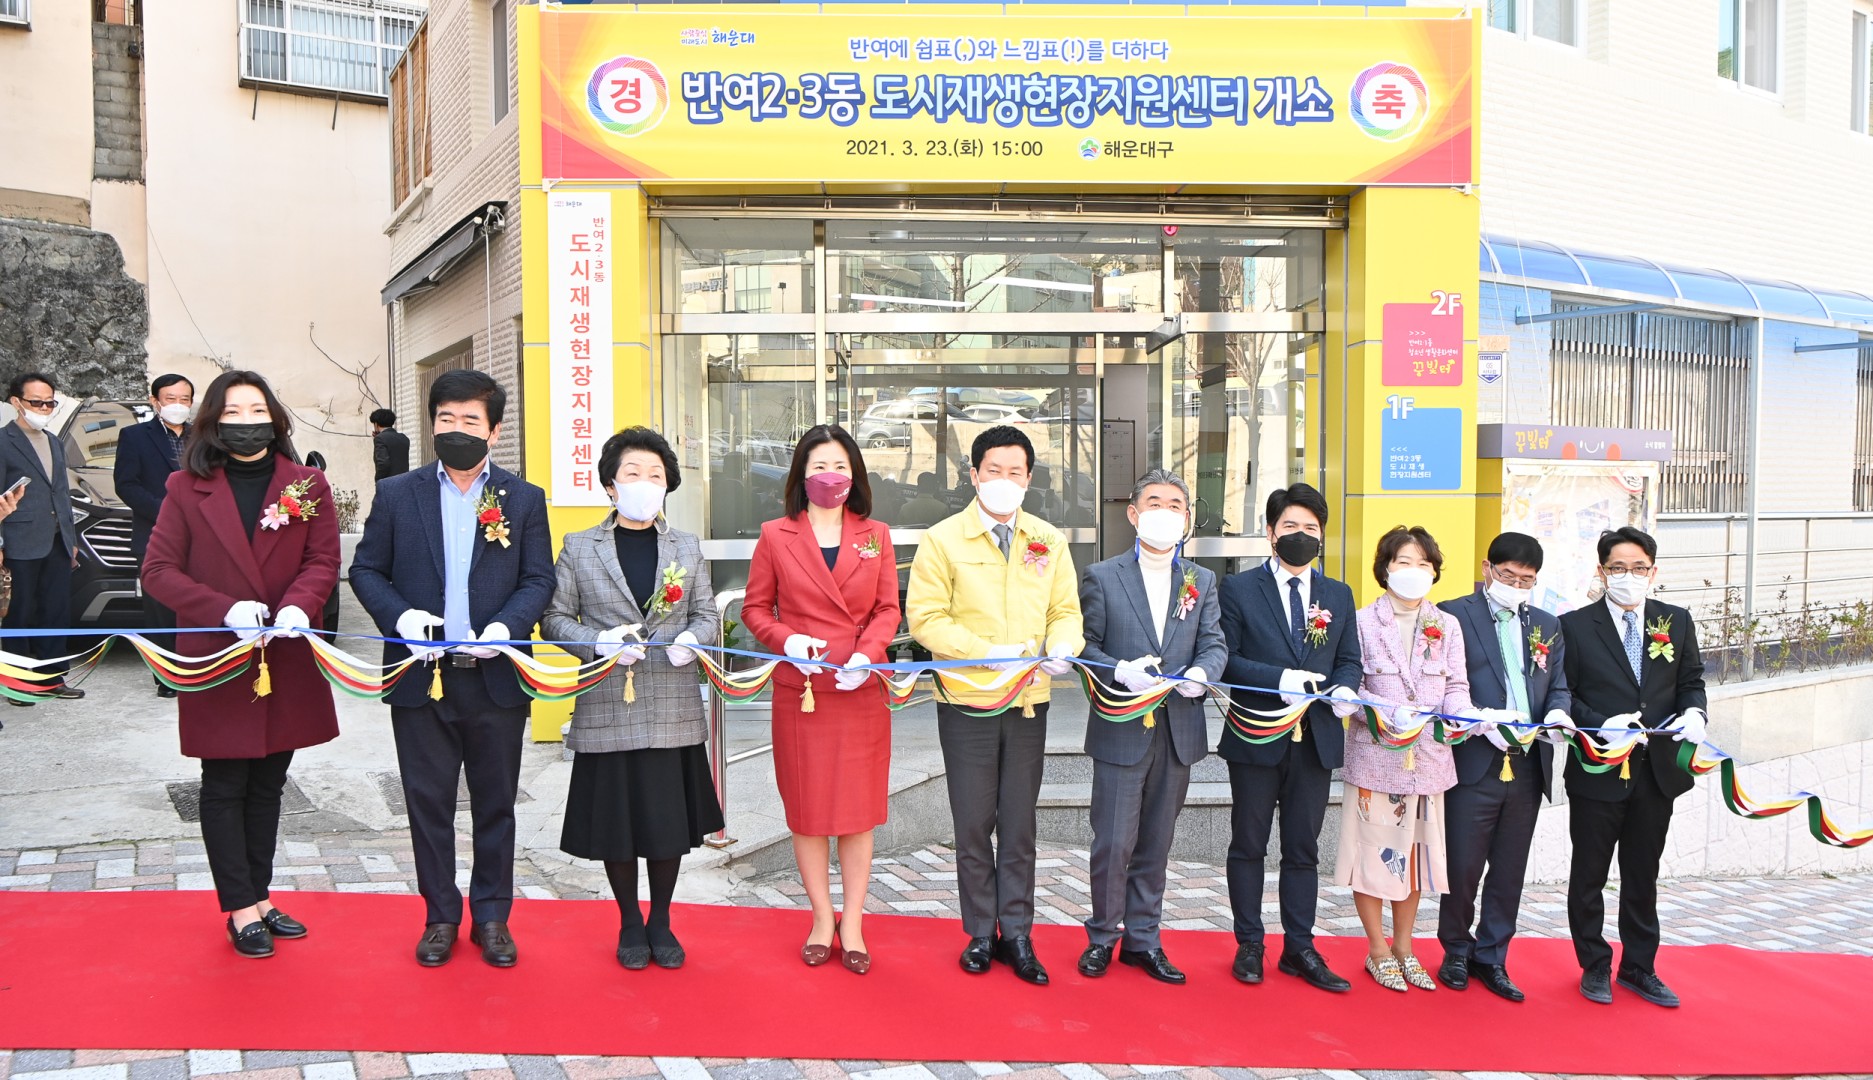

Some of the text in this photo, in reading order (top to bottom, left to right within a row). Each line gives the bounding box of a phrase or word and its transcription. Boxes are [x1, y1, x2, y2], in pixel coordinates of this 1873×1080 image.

[712, 30, 755, 47] 해운대
[850, 38, 1169, 62] 반여에 쉼표(,)와 느낌표(!)를 더하다
[609, 77, 642, 114] 경
[681, 71, 1333, 128] 반여2·3동 도시재생현장지원센터 개소
[1371, 84, 1407, 119] 축
[846, 139, 1043, 158] 2021. 3. 23.(화) 15:00
[1104, 140, 1174, 159] 해운대구
[1431, 290, 1461, 316] 2F
[569, 234, 593, 491] 도시재생현장지원센터
[1386, 394, 1415, 420] 1F
[1390, 471, 1432, 479] 현장지원센터
